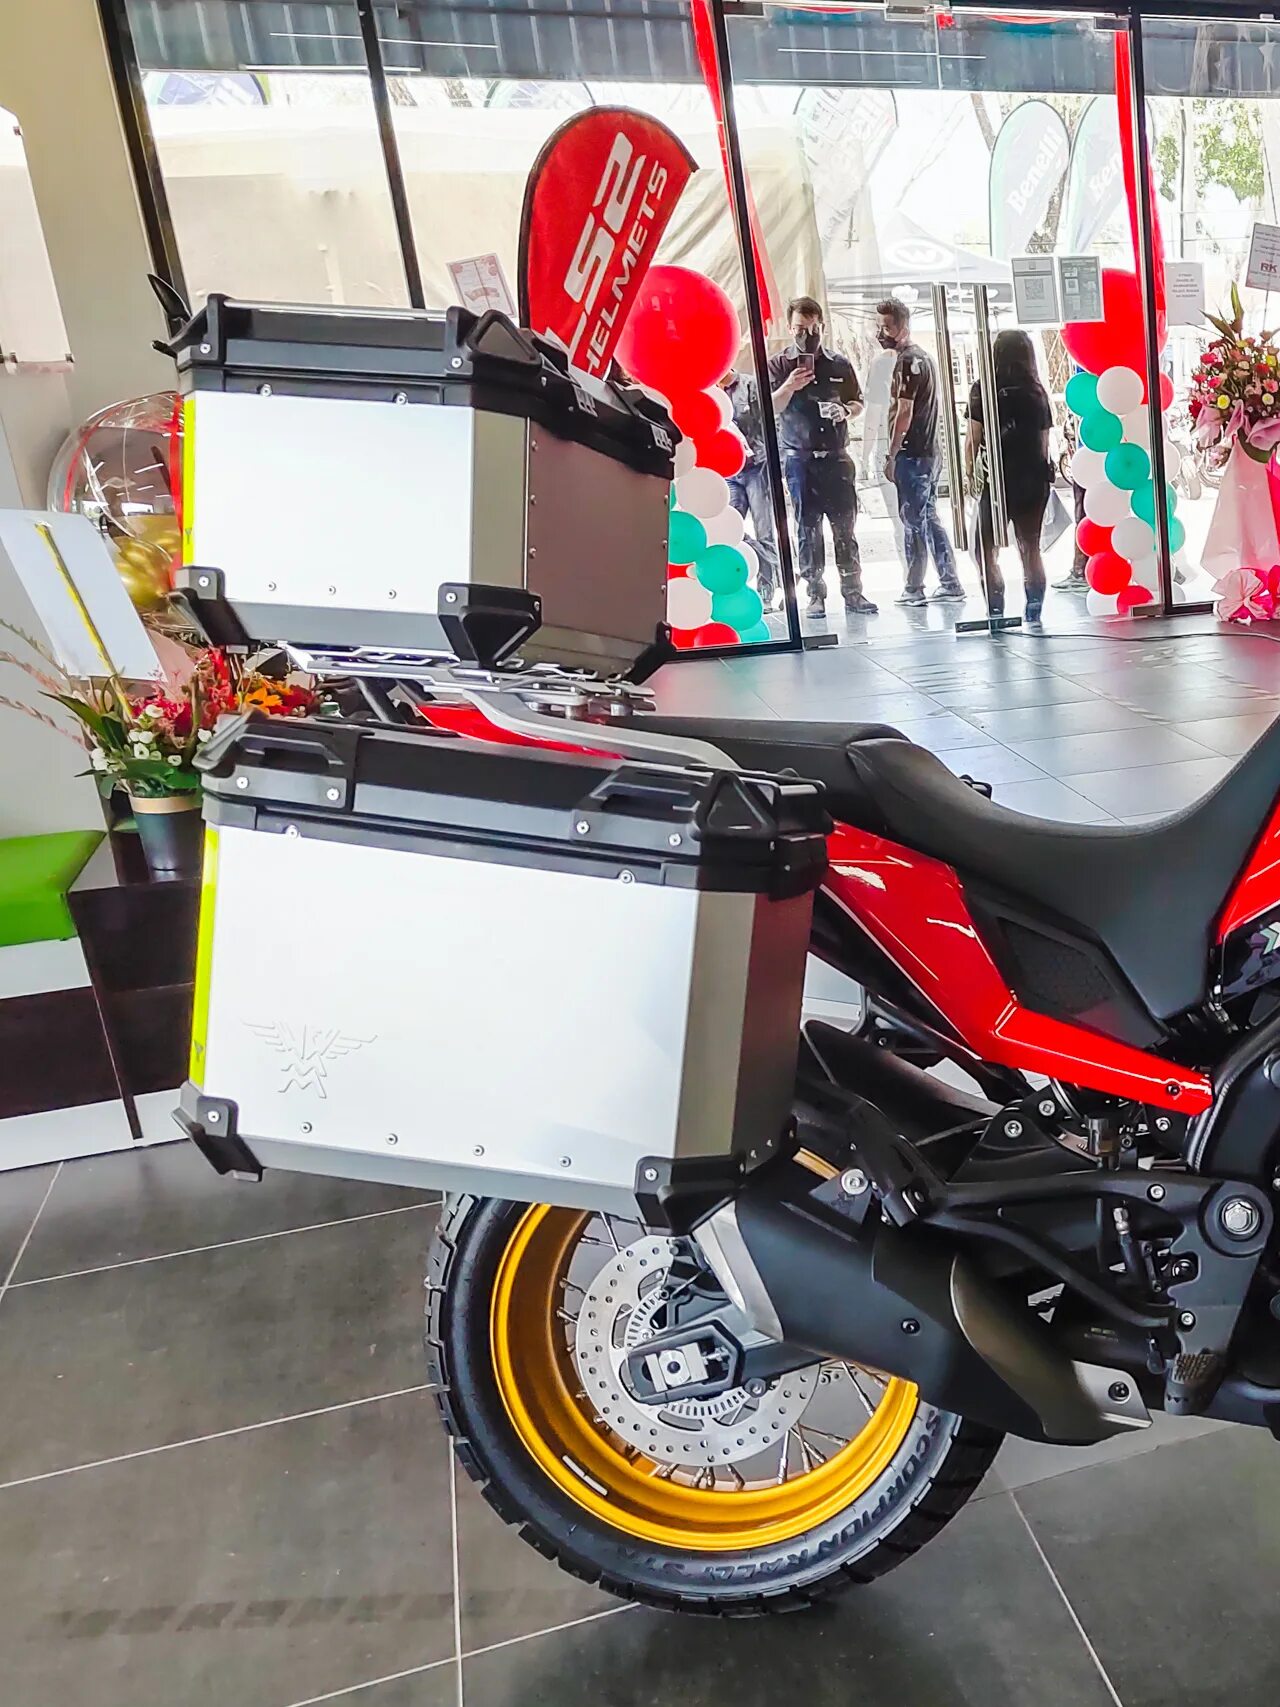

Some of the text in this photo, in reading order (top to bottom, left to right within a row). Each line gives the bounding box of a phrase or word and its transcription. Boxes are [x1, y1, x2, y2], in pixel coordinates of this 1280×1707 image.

[1006, 125, 1064, 215] Benelli
[544, 131, 647, 365] LS2
[1260, 262, 1278, 273] RK
[818, 1409, 942, 1559] SCORPION
